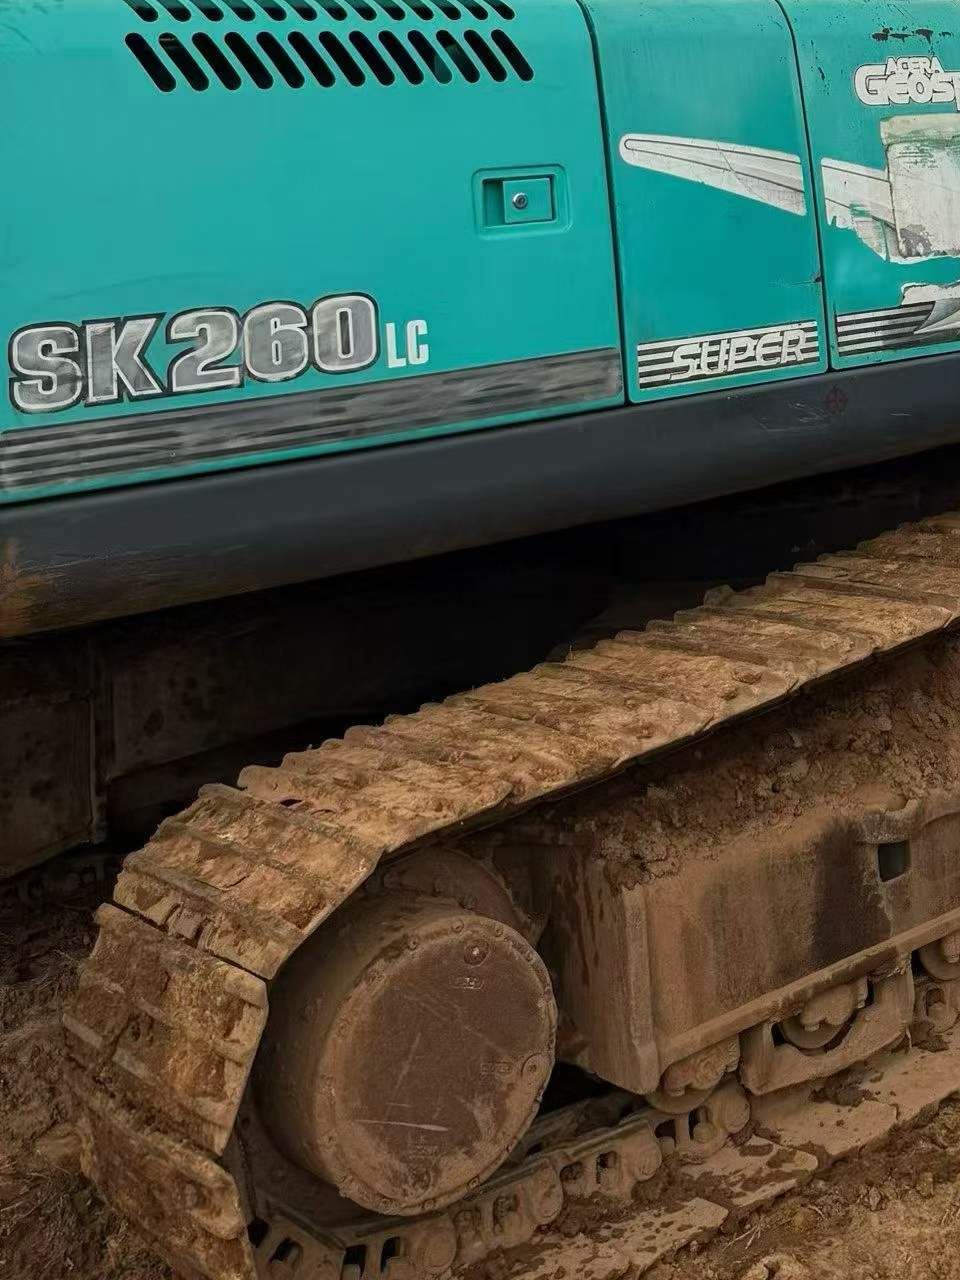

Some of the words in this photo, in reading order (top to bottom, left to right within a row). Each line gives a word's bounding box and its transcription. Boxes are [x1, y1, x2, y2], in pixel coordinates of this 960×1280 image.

[8, 291, 380, 413] SK260
[385, 319, 430, 368] LC
[669, 328, 807, 381] SUPER
